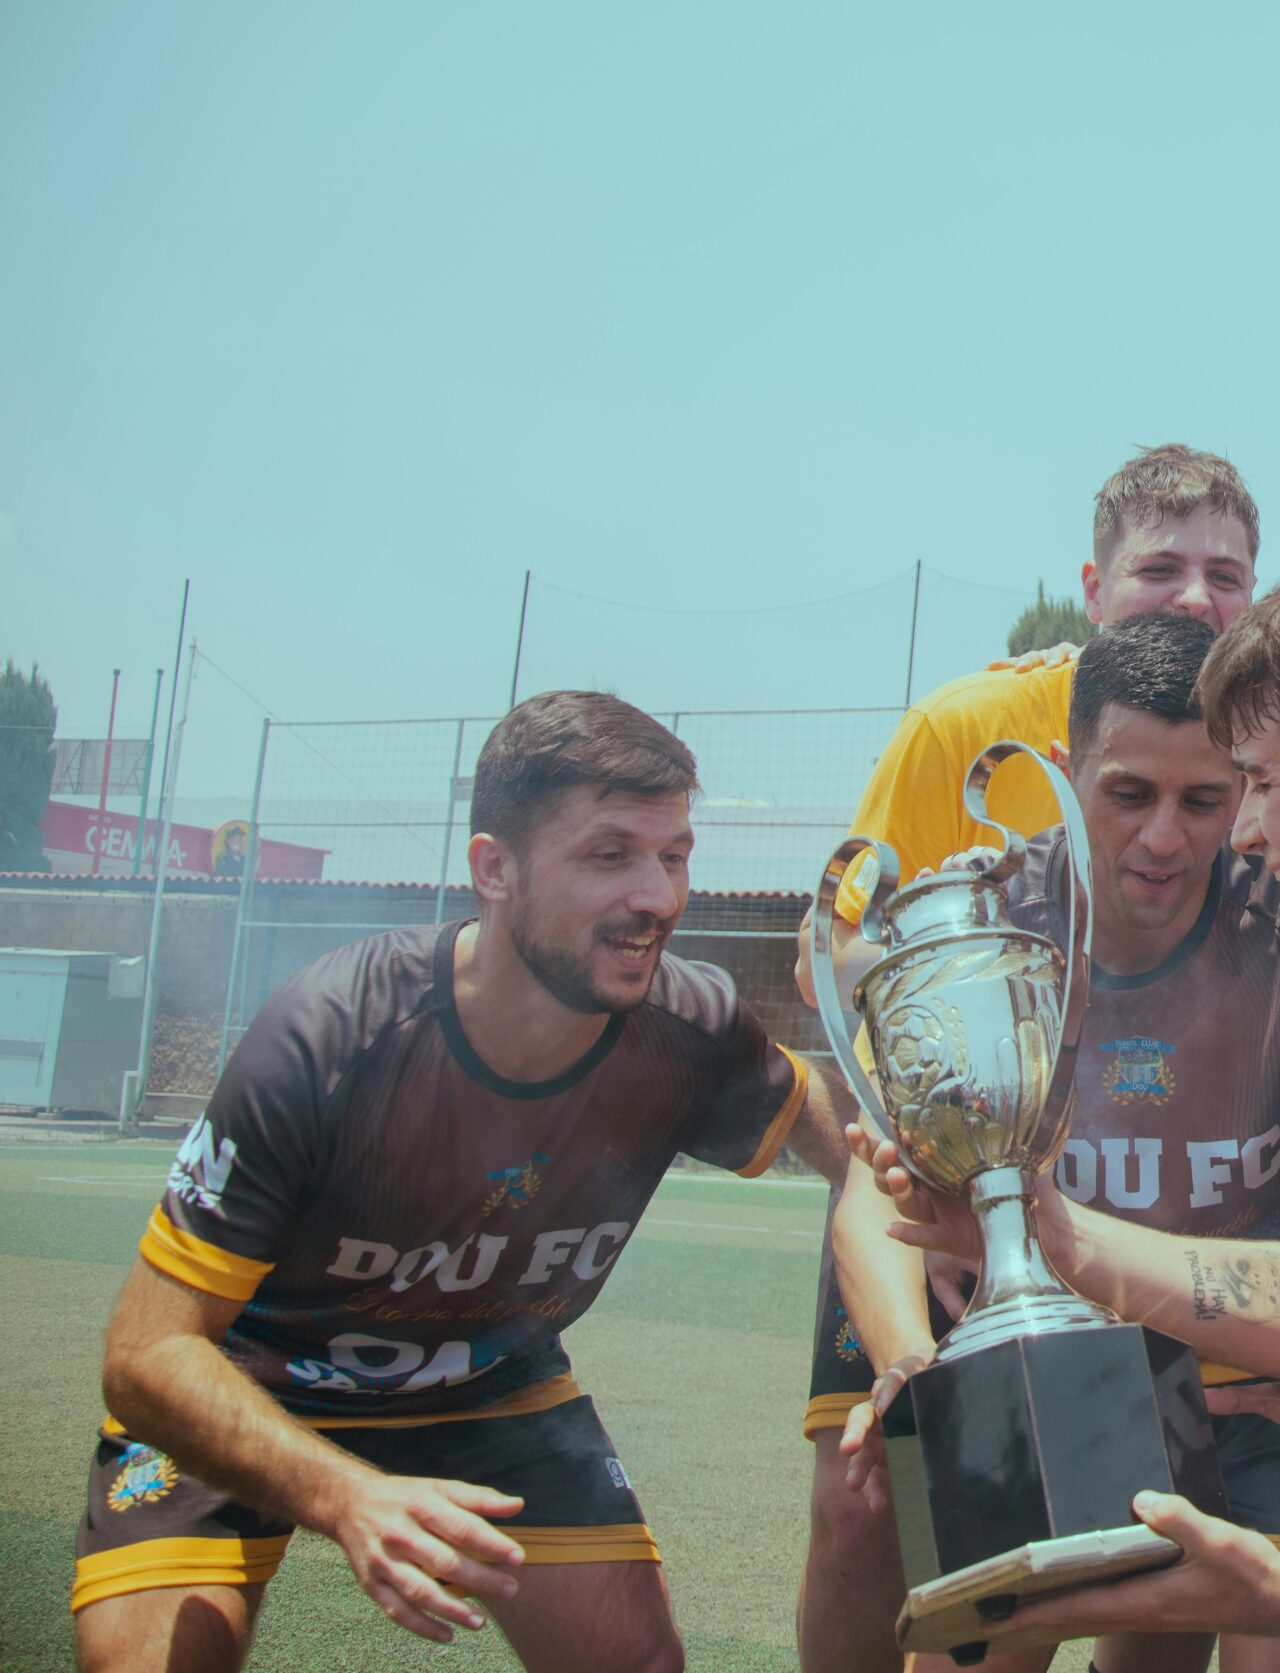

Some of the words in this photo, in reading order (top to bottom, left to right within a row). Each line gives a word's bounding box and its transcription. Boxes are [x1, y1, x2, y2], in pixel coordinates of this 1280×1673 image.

[1055, 1138, 1162, 1208] OU
[326, 1232, 509, 1292] DOU
[517, 1221, 631, 1285] FC
